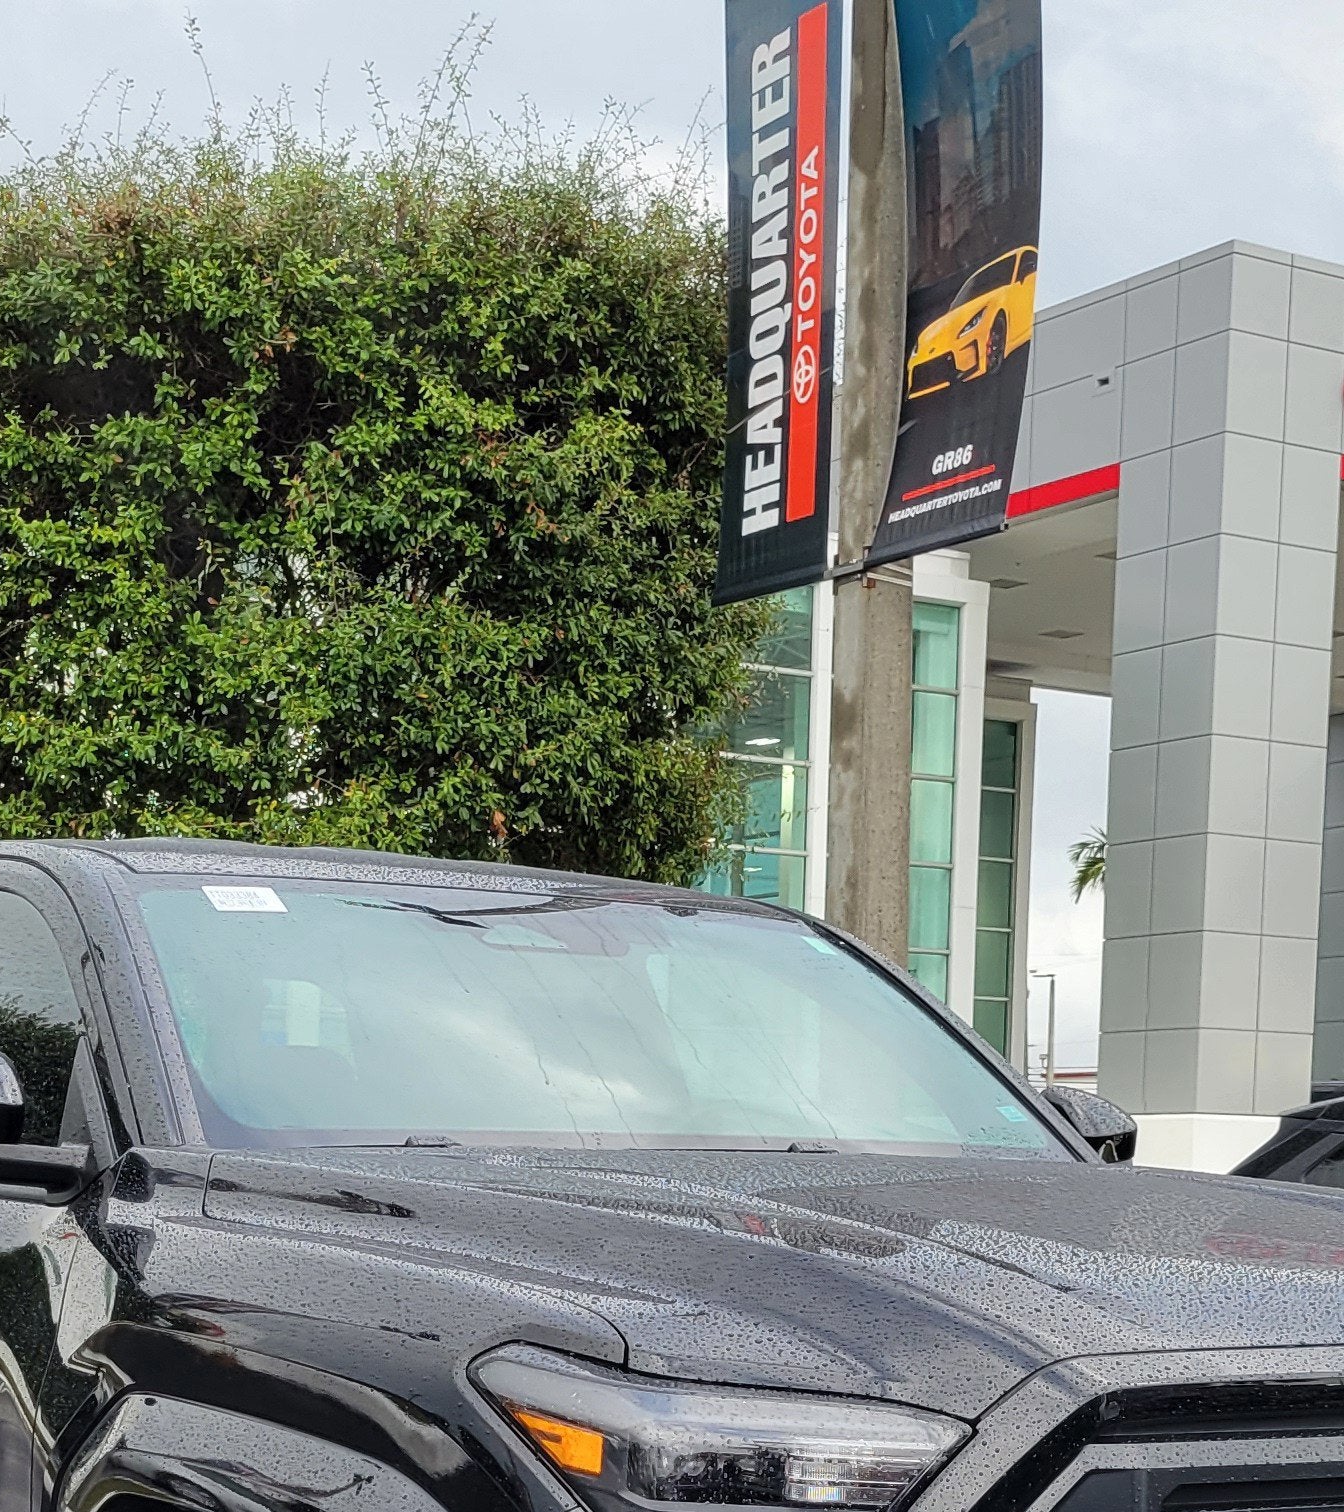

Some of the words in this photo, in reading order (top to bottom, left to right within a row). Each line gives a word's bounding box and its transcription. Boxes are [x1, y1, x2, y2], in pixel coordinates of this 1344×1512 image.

[742, 27, 791, 537] HEADQUARTER
[795, 146, 819, 328] TOYOTA
[888, 479, 1003, 524] HEADQUARTERTOYOTA.COM
[932, 444, 973, 475] GR86
